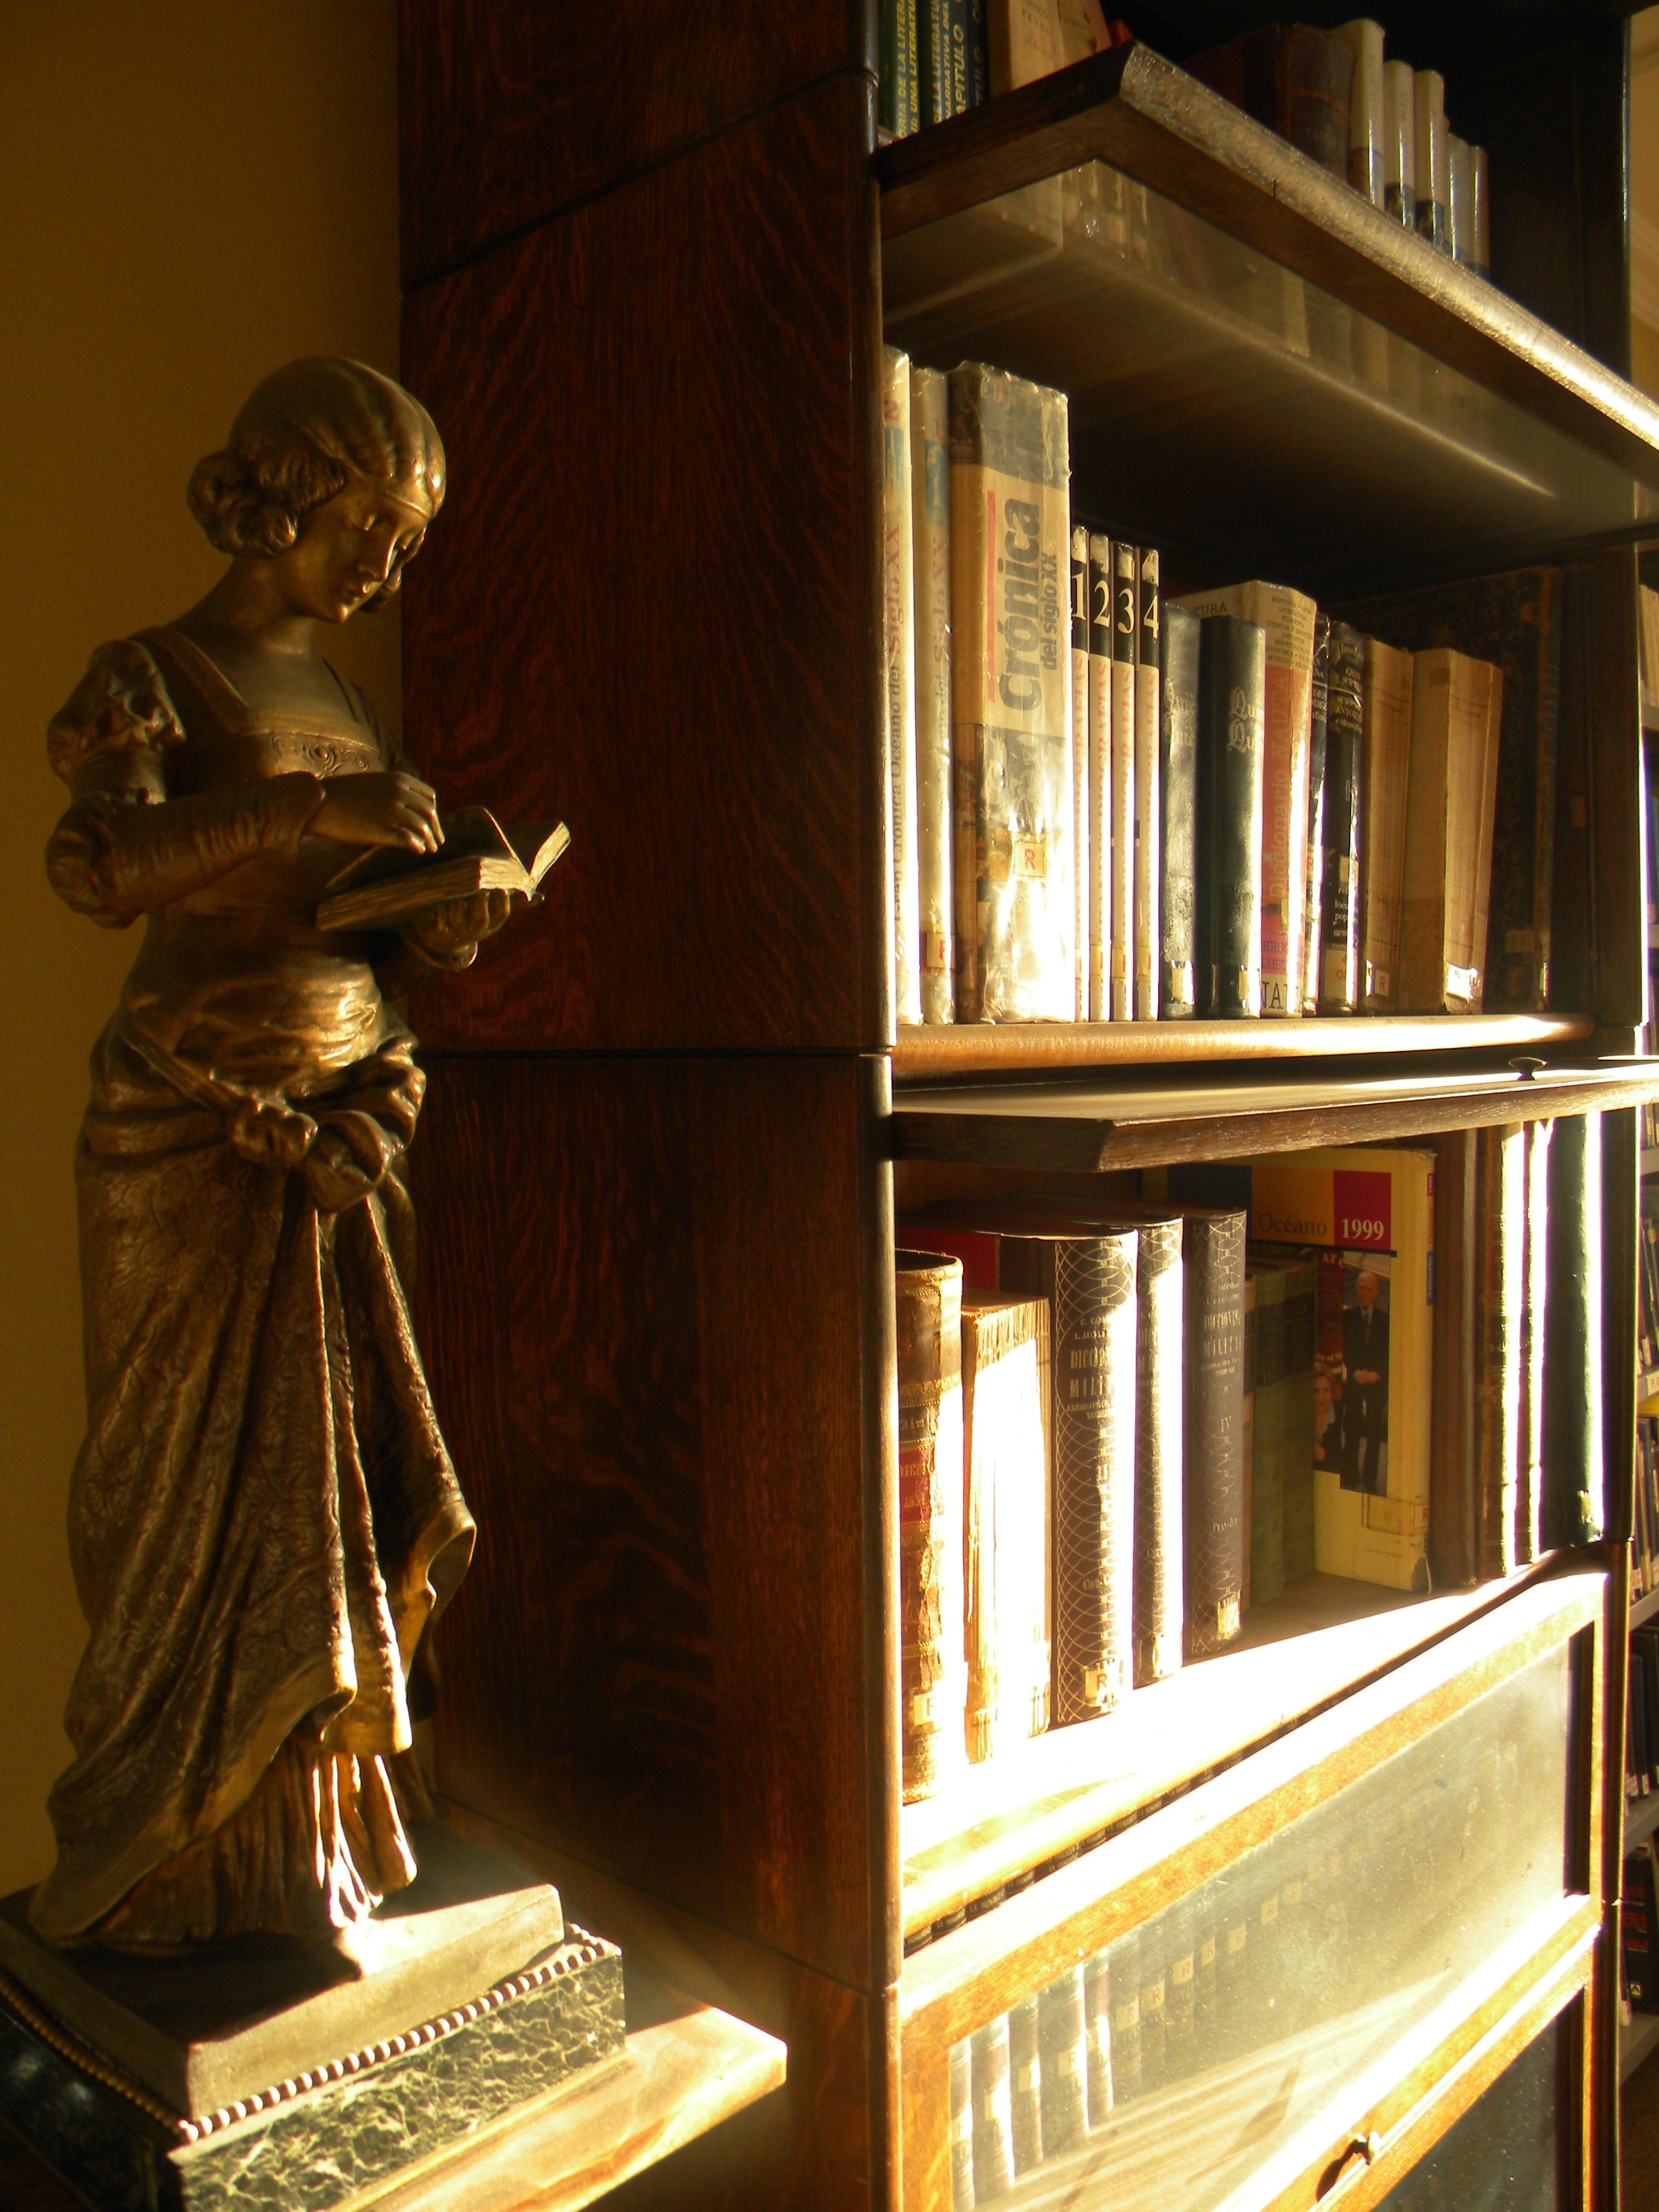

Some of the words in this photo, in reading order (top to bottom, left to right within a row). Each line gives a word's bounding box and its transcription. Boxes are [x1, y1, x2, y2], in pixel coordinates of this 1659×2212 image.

[897, 53, 907, 73] LA
[897, 78, 907, 99] DE
[932, 82, 942, 101] LA
[886, 524, 900, 572] XX
[888, 576, 904, 655] Siglo
[997, 498, 1044, 711] Crónica
[1039, 585, 1060, 634] siglo
[1071, 573, 1086, 622] 1
[1094, 580, 1111, 628] 2
[1118, 588, 1134, 635] 3
[1143, 595, 1159, 640] 4
[1040, 637, 1057, 671] del
[1271, 677, 1289, 760] NAUTA
[1270, 769, 1289, 898] Diccionario
[1379, 976, 1386, 990] R
[1259, 1213, 1328, 1236] Océano
[1342, 1218, 1385, 1241] 1999
